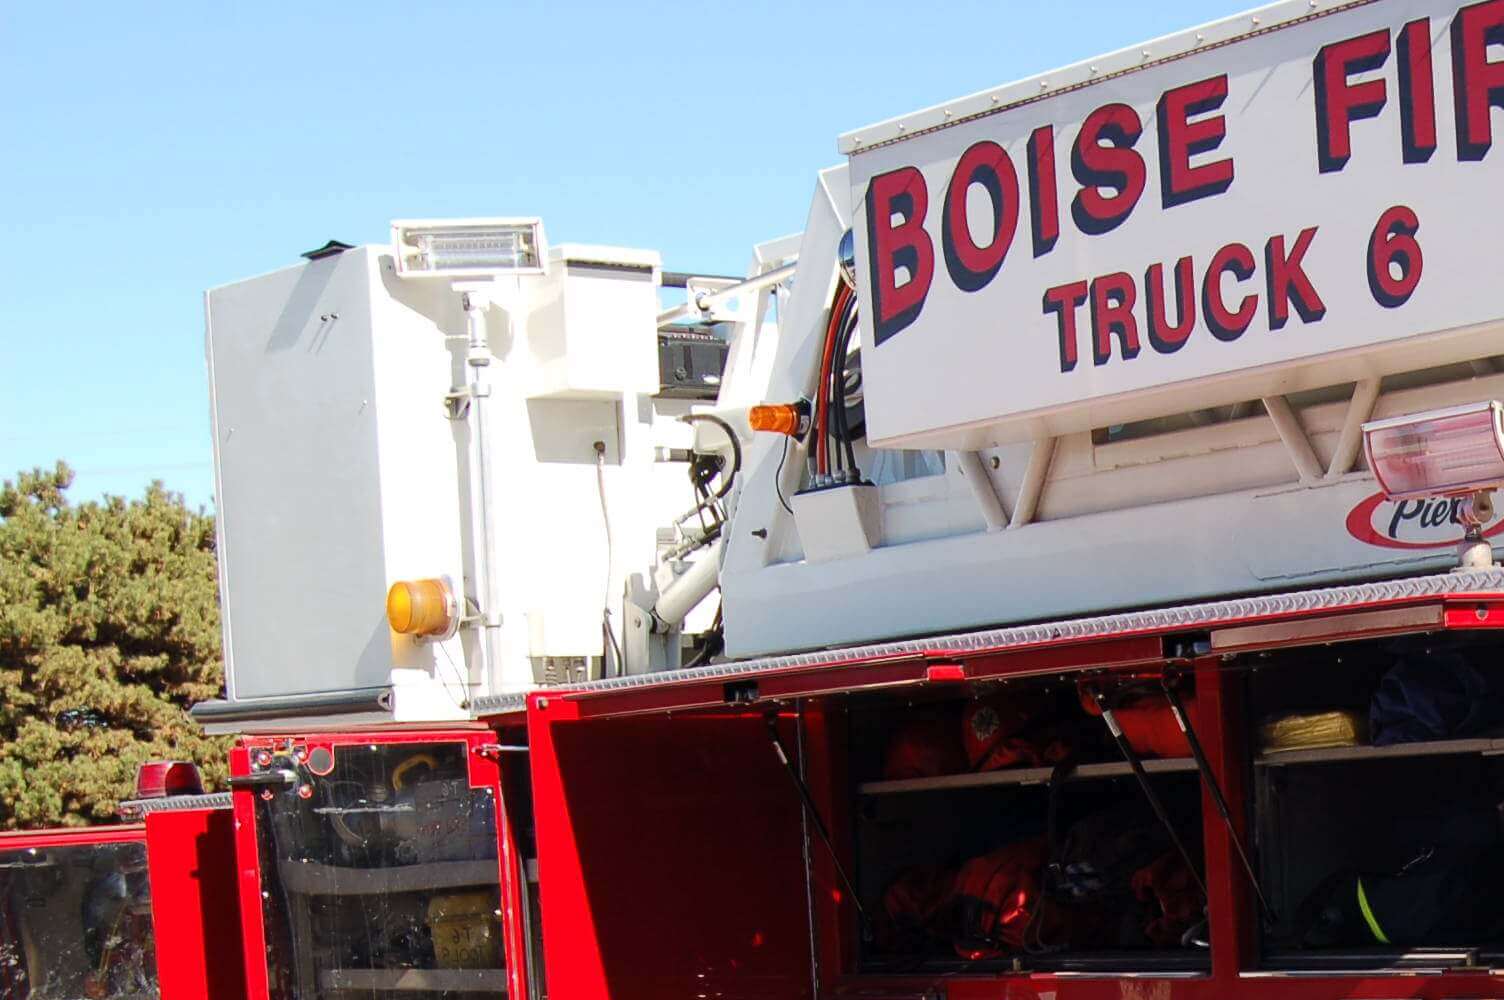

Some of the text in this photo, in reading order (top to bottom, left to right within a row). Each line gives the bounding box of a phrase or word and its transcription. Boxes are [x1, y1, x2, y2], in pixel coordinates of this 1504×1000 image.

[865, 74, 1234, 346] BOISE
[1043, 205, 1425, 374] TRUCK 6
